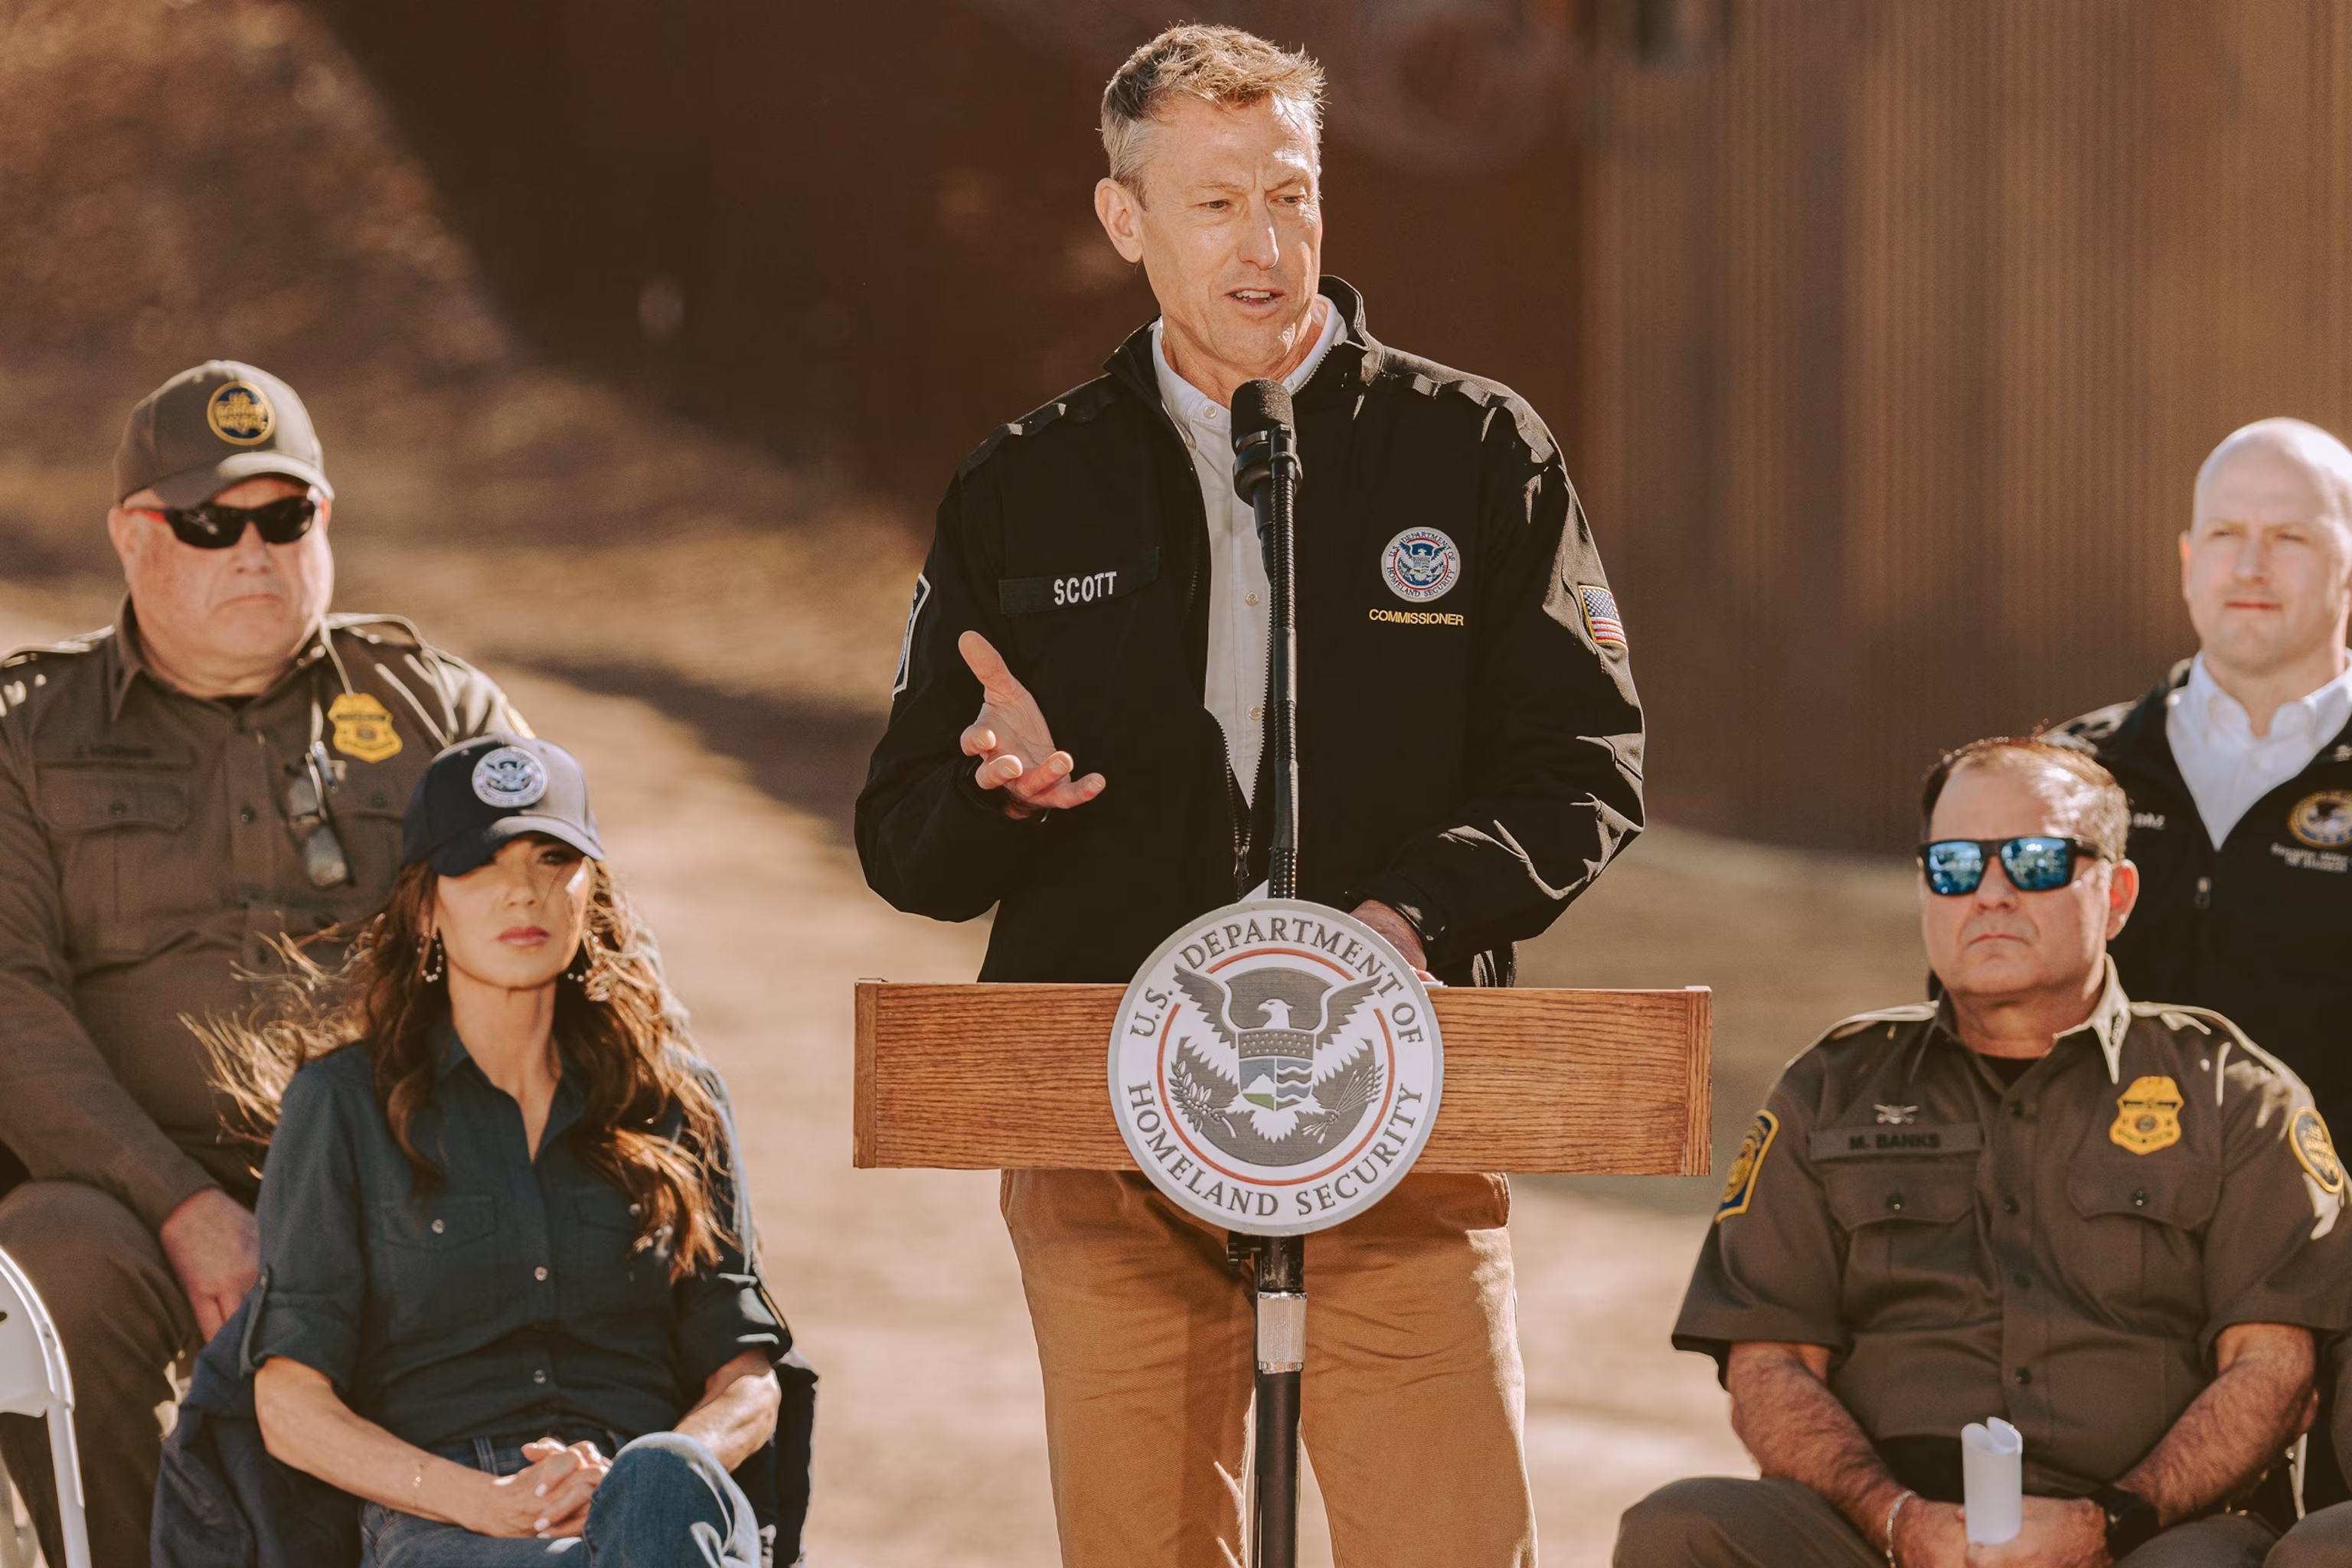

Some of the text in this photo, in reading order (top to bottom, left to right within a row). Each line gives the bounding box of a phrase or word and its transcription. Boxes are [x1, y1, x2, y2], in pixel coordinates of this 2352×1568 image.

[1401, 531, 1451, 550] DEPARTMENT
[1447, 551, 1455, 561] OF
[1054, 571, 1117, 605] SCOTT
[1387, 567, 1455, 596] HOMELAND SECURITY
[1369, 609, 1464, 626] COMMISSIONER
[1129, 917, 1425, 1044] U.S. DEPARTMENT OF
[1127, 1080, 1423, 1216] HOMELAND SECURITY
[1876, 1133, 1940, 1148] BANKS
